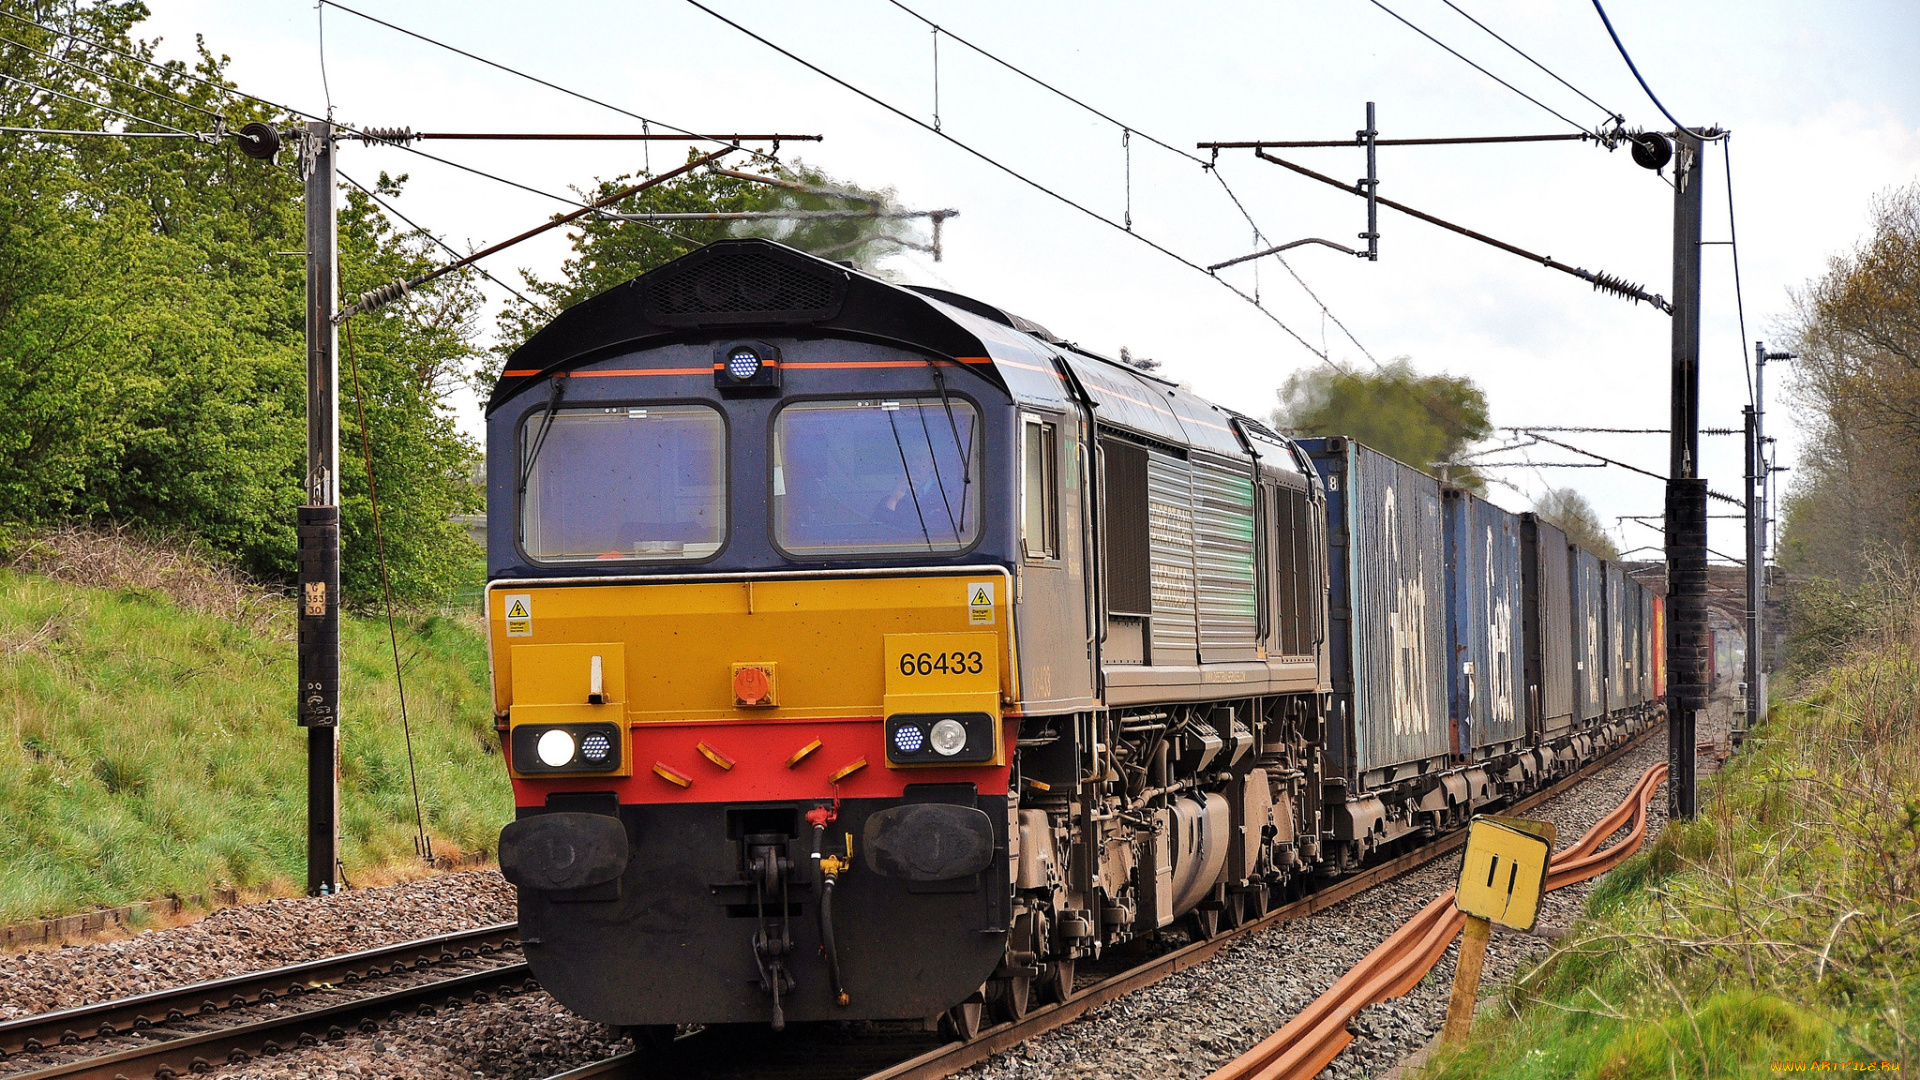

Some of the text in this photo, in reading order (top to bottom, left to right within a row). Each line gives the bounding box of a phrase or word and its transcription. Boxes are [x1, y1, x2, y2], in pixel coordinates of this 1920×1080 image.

[1330, 476, 1337, 491] 8
[307, 595, 324, 603] 353
[309, 606, 321, 614] 30
[900, 651, 983, 676] 66433
